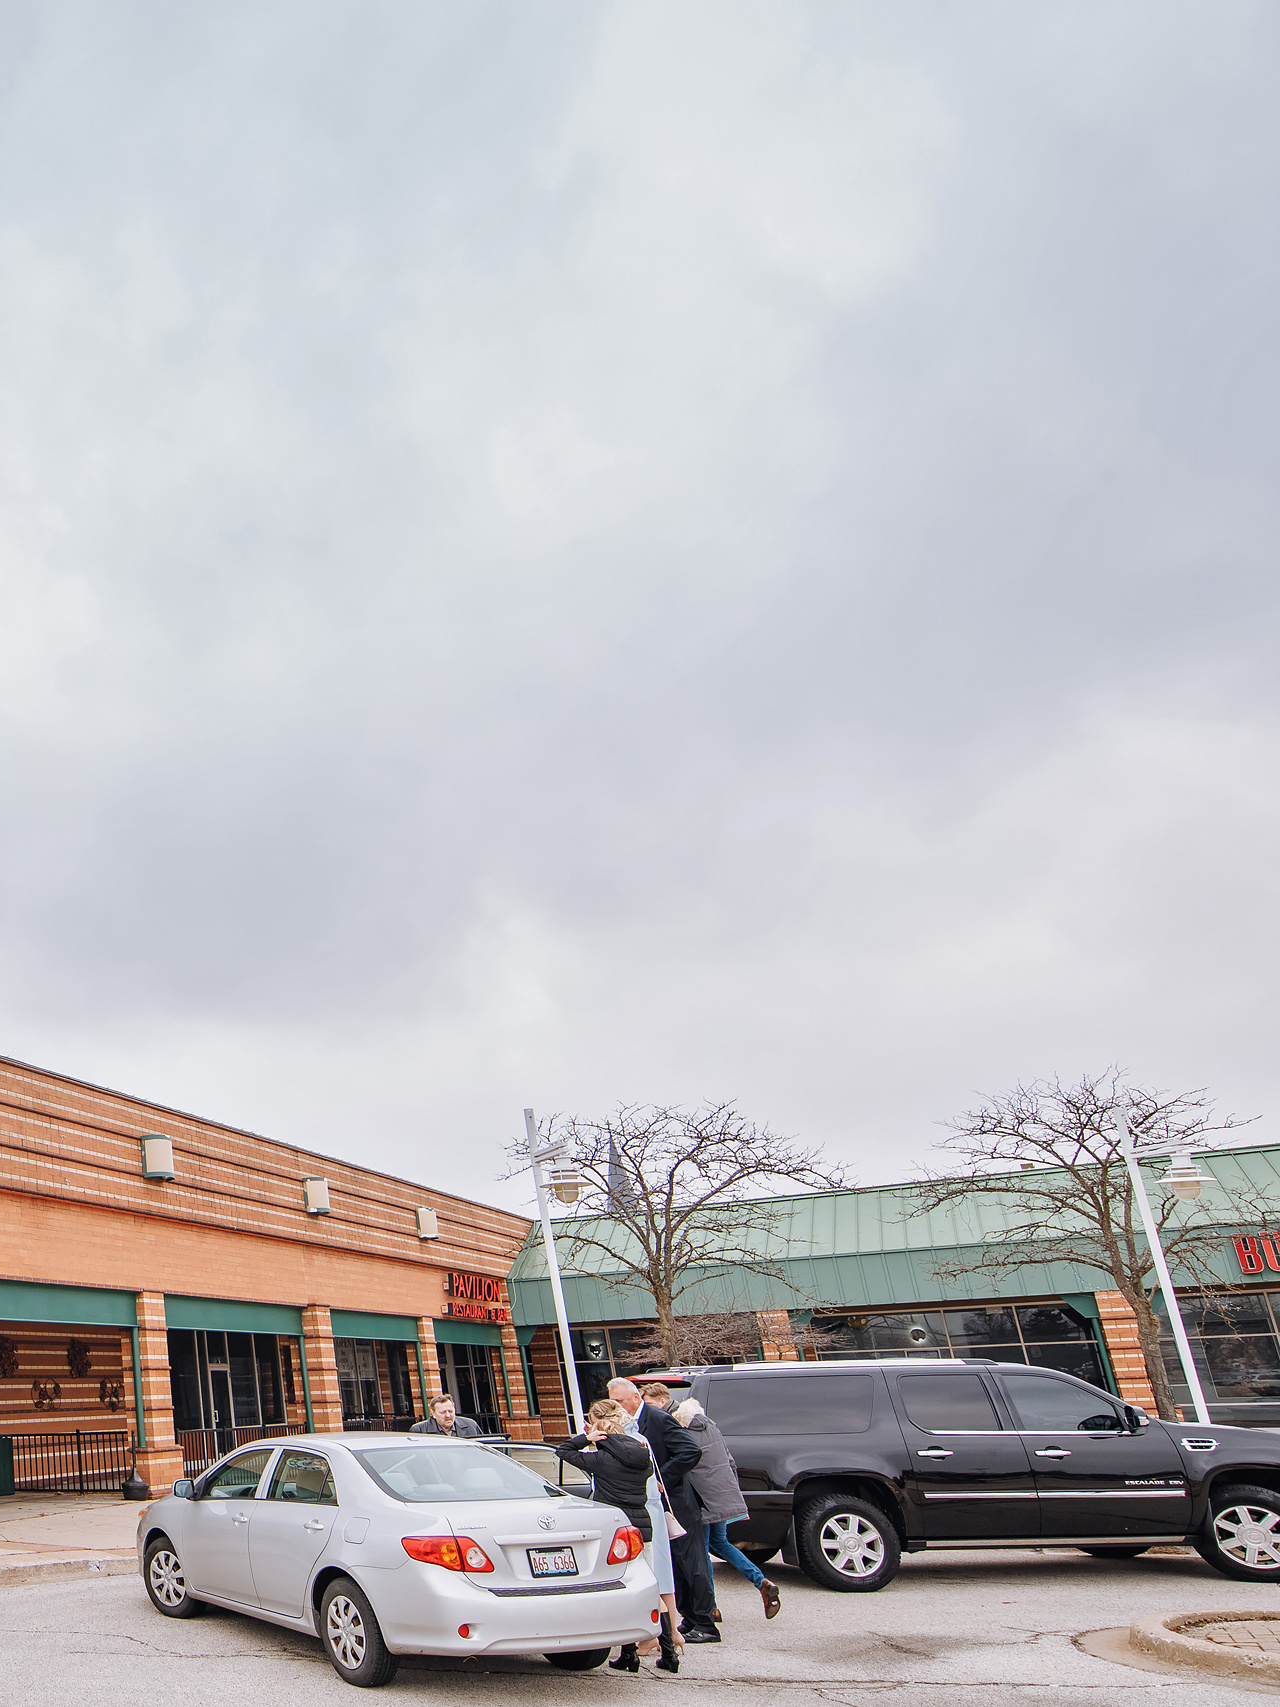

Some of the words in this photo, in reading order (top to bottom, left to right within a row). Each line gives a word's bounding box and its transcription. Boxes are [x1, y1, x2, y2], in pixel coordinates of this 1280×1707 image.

[451, 1272, 500, 1302] PAVILION
[452, 1302, 489, 1319] RESTAURANT
[533, 1556, 549, 1572] A65
[553, 1555, 575, 1571] 6366
